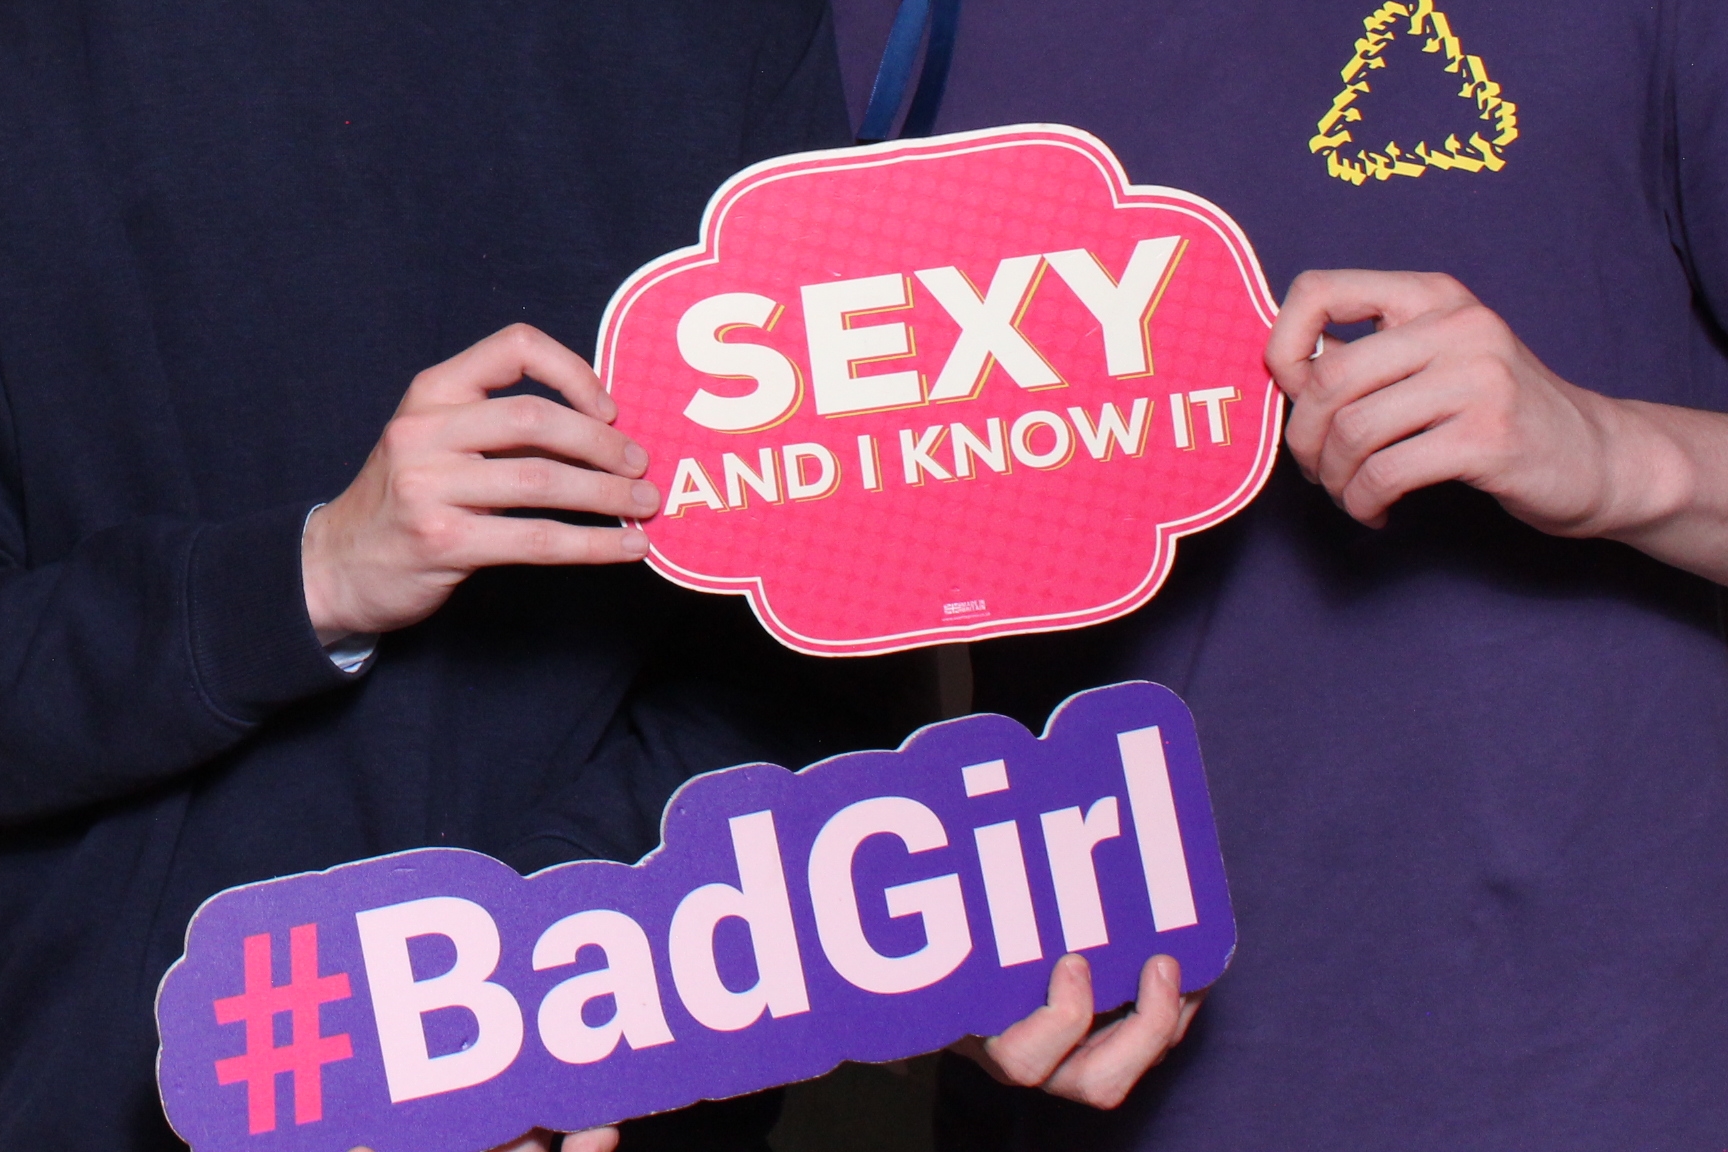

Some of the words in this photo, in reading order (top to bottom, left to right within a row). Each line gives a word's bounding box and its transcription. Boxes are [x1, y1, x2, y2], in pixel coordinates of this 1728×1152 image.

[676, 235, 1189, 435] SEXY
[663, 441, 841, 519] AND
[859, 434, 883, 493] I
[899, 397, 1154, 487] KNOW
[1169, 386, 1241, 451] IT
[213, 724, 1199, 1136] #BadGirl
